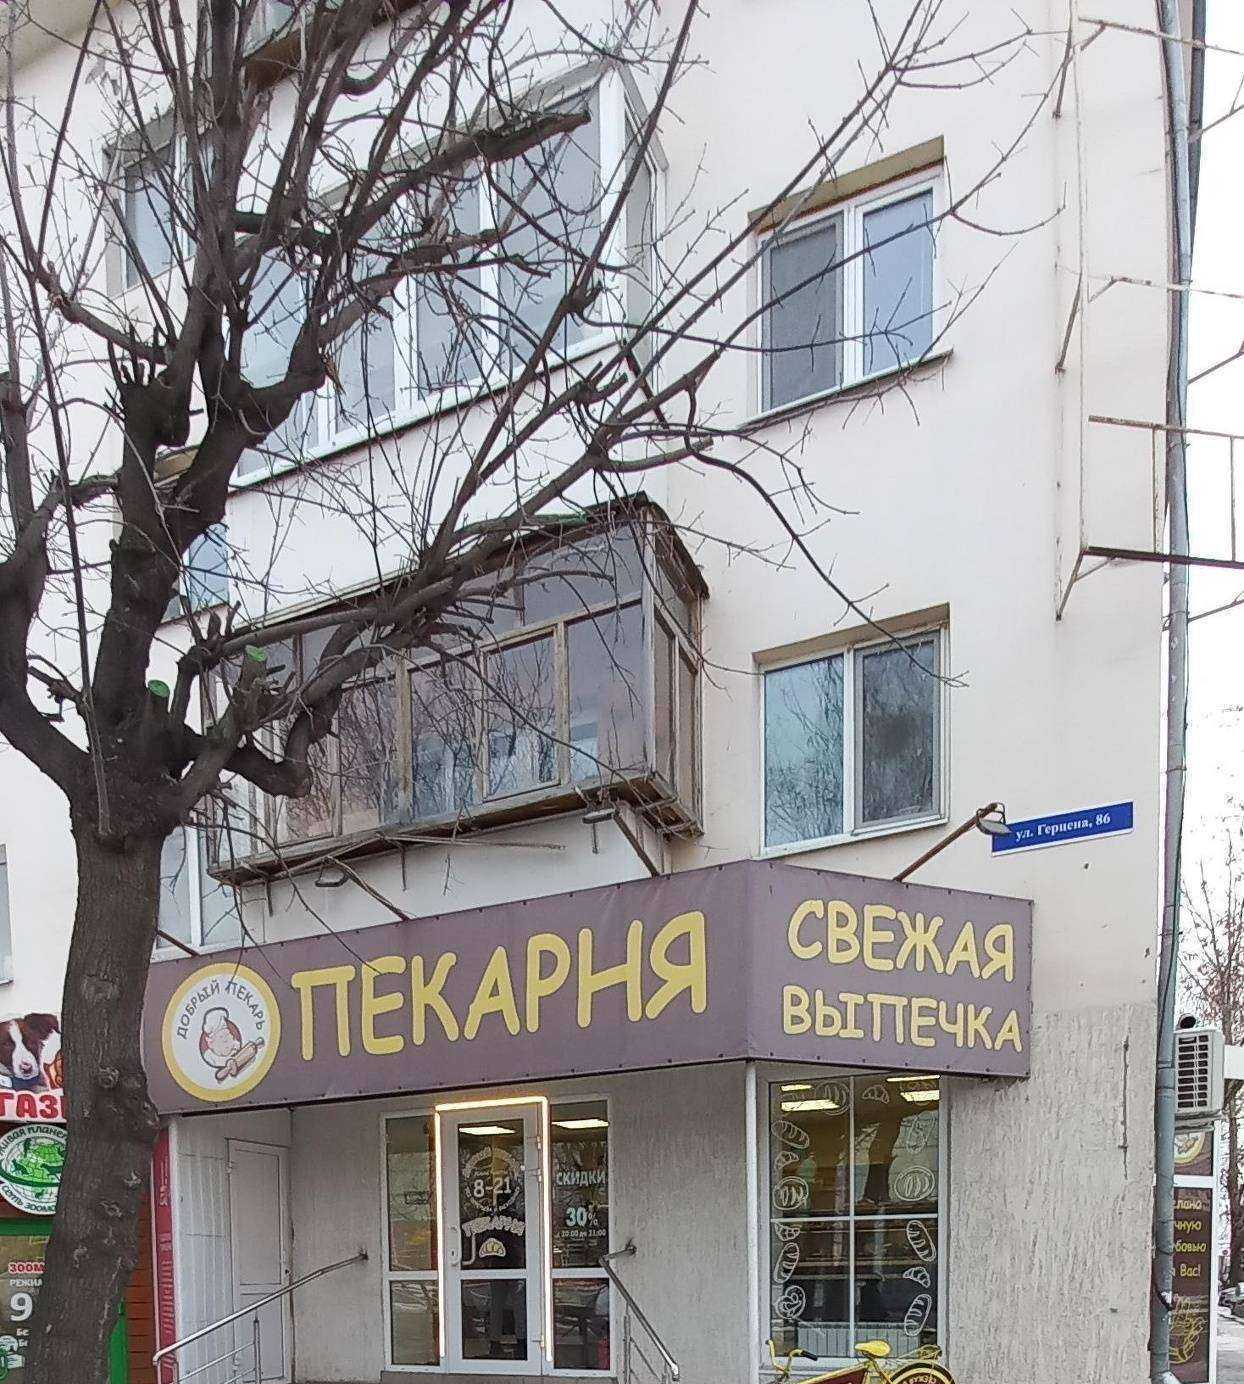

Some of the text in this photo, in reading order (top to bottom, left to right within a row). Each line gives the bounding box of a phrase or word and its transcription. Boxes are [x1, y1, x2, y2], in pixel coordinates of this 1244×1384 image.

[1015, 813, 1111, 842] ул. Герцена, 86
[788, 899, 1014, 983] СВЕЖАЯ
[291, 910, 708, 1062] ПЕКАРНЯ
[176, 978, 266, 1040] ДОБРЫЙ ПЕКАРЬ
[782, 984, 1023, 1053] ВЫПЕЧКА
[0, 1091, 65, 1119] ГАЗ
[473, 1176, 512, 1198] 8-21
[555, 1169, 606, 1187] СКИДКИ
[1174, 1222, 1202, 1235] чную
